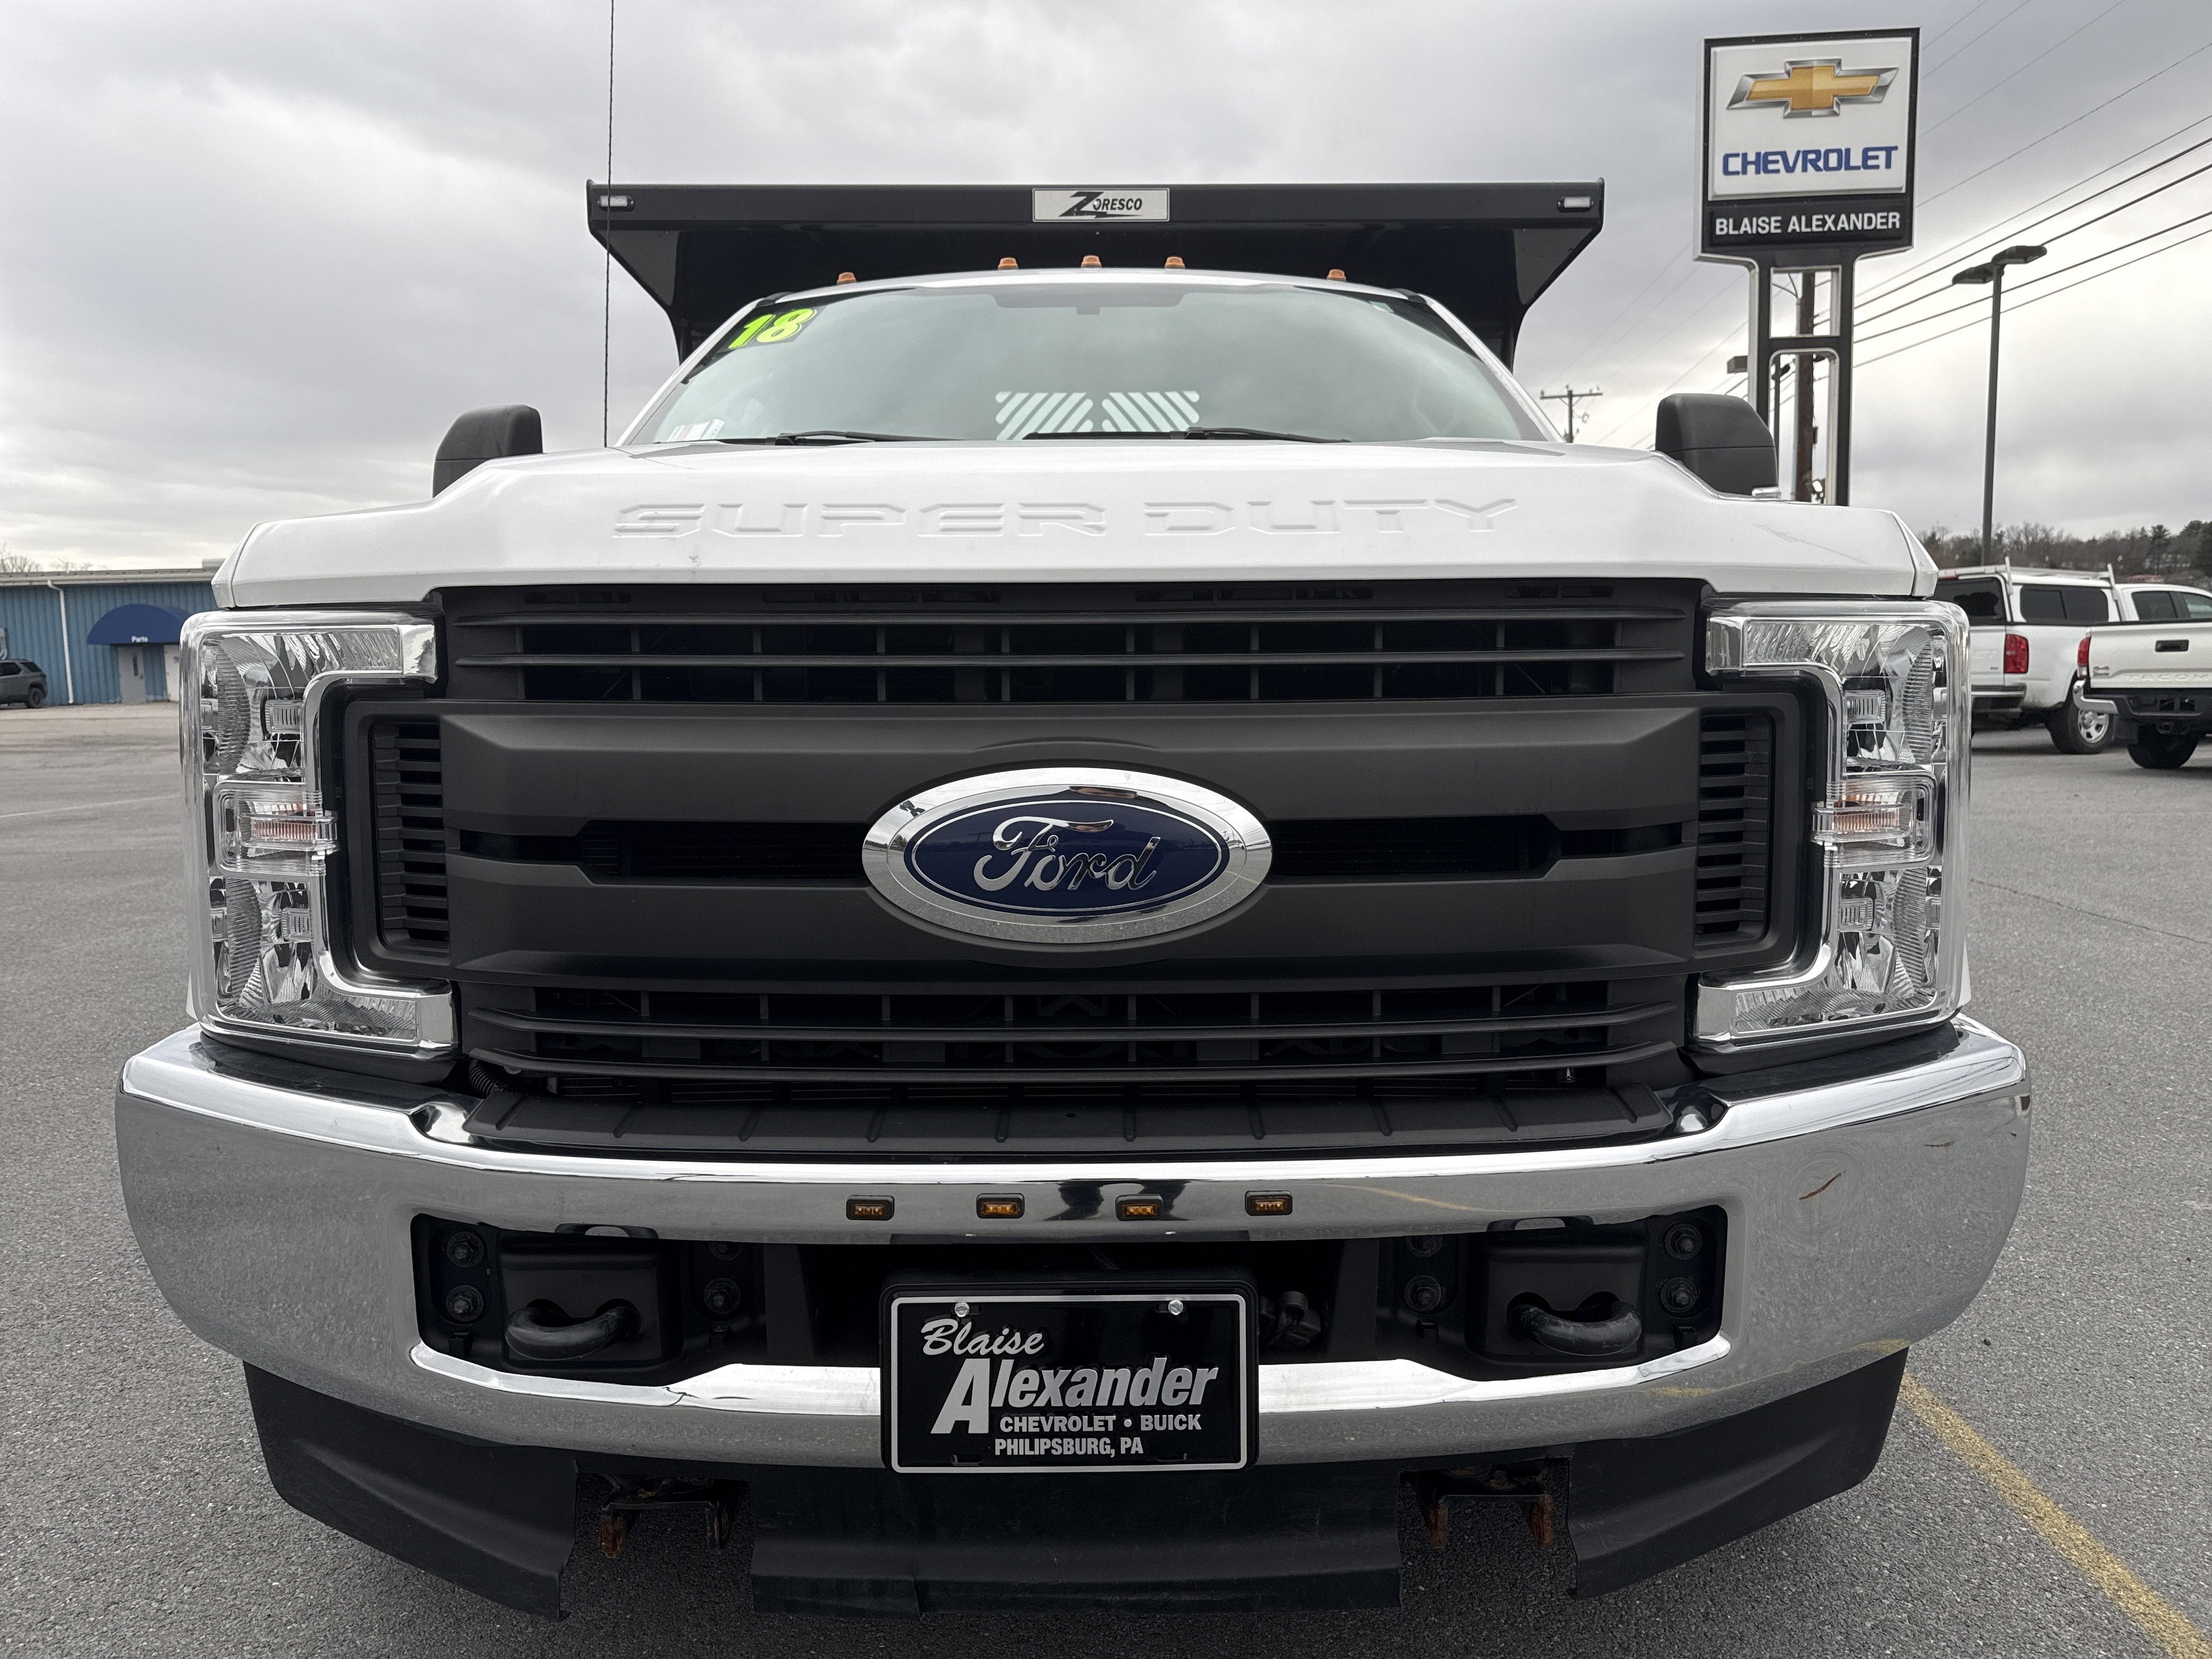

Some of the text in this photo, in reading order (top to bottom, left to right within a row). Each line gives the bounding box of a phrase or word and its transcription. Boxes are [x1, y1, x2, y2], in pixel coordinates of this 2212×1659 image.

[1722, 146, 1898, 176] CHEVROLET
[1058, 191, 1143, 219] ZORESCO
[1715, 212, 1900, 235] BLAISE ALEXANDER
[728, 308, 817, 349] 18
[612, 498, 1518, 538] SUPER DUTY
[973, 816, 1161, 891] Ford
[921, 1318, 1045, 1356] Blaise
[930, 1357, 1219, 1434] Alexander
[1000, 1414, 1202, 1432] CHEVROLET BUICK
[995, 1437, 1144, 1458] PHILIPSBURG, PA
